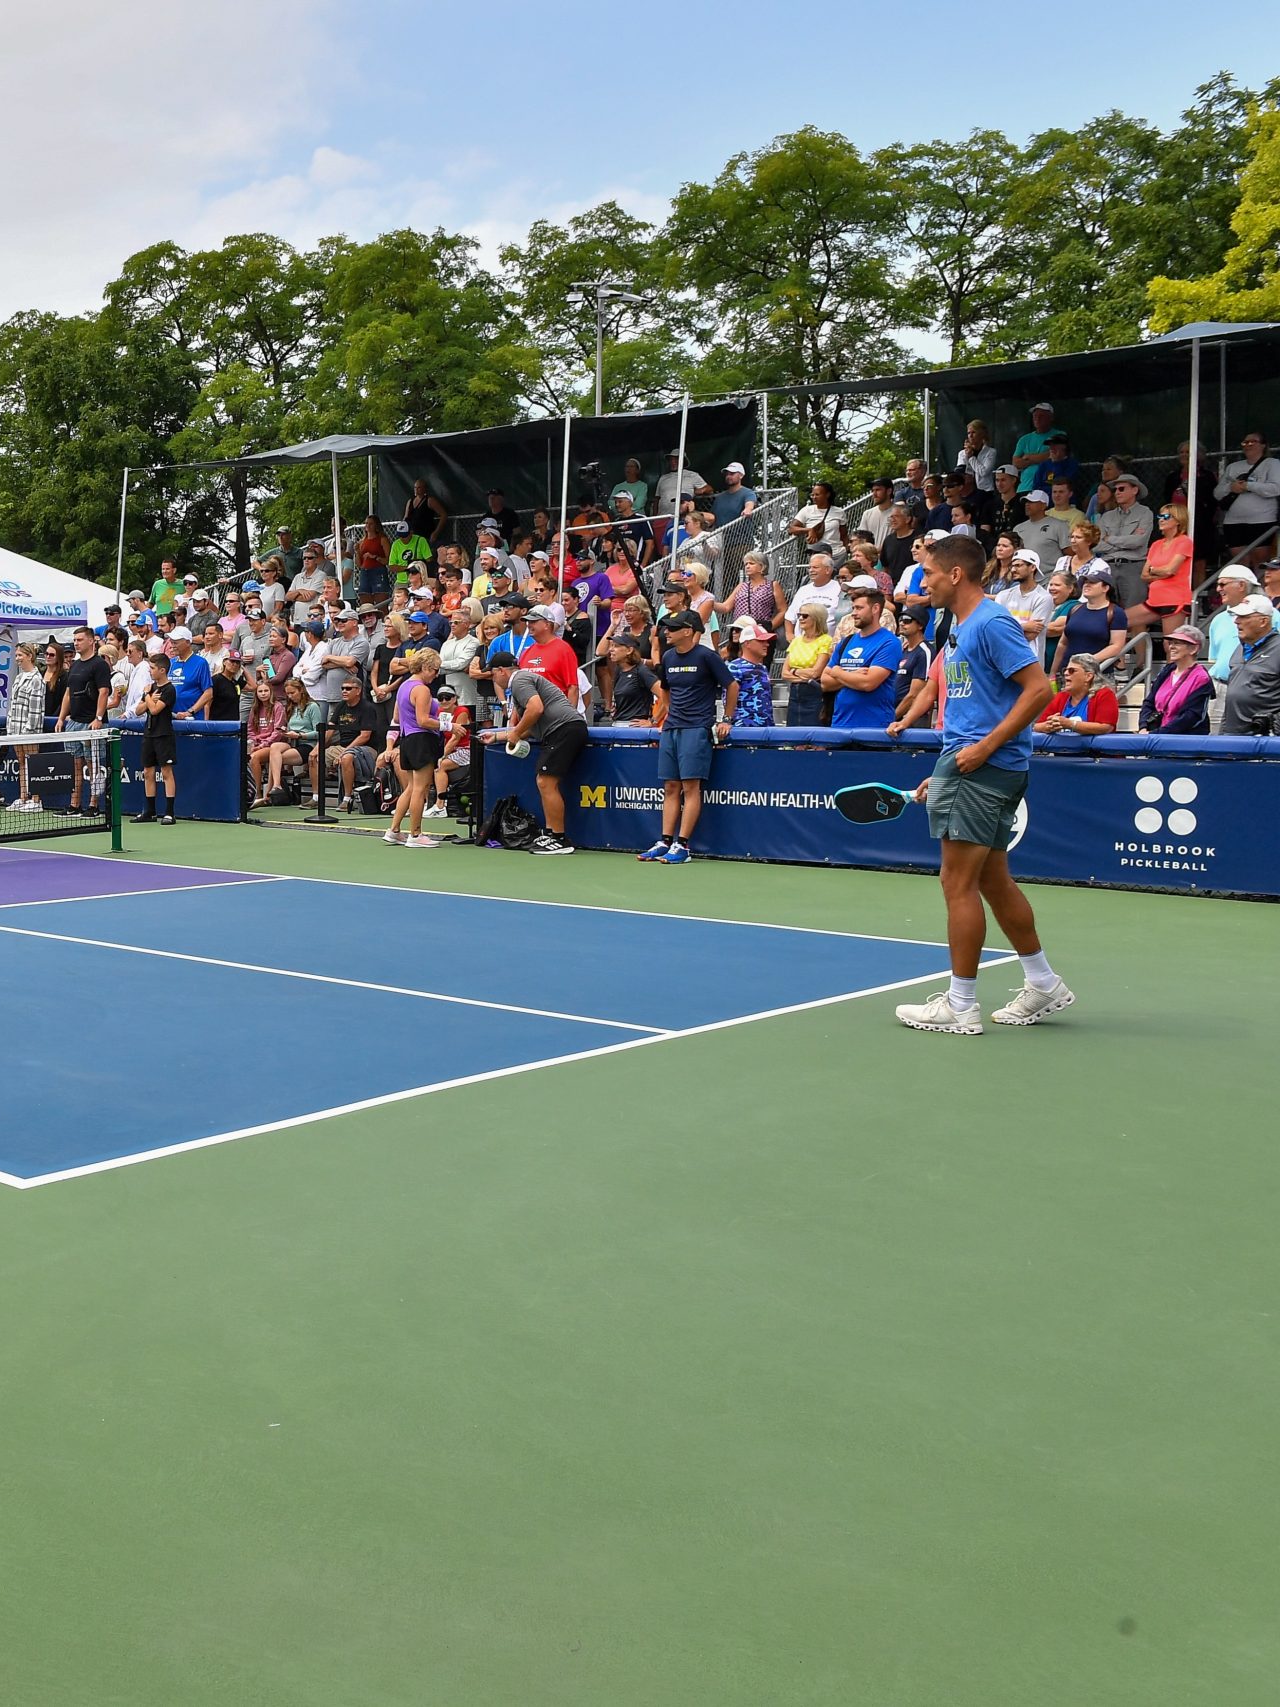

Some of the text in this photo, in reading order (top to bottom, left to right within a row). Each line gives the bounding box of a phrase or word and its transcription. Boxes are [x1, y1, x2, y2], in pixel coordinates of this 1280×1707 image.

[54, 605, 82, 617] Club
[30, 774, 73, 782] PADDLETEK
[580, 785, 837, 810] M UNIVERS MICHIGAN HEALTH-W
[615, 801, 652, 810] MICHIGAN
[1114, 842, 1216, 857] HOLBROOK
[1120, 858, 1207, 872] PICKLEBALL
